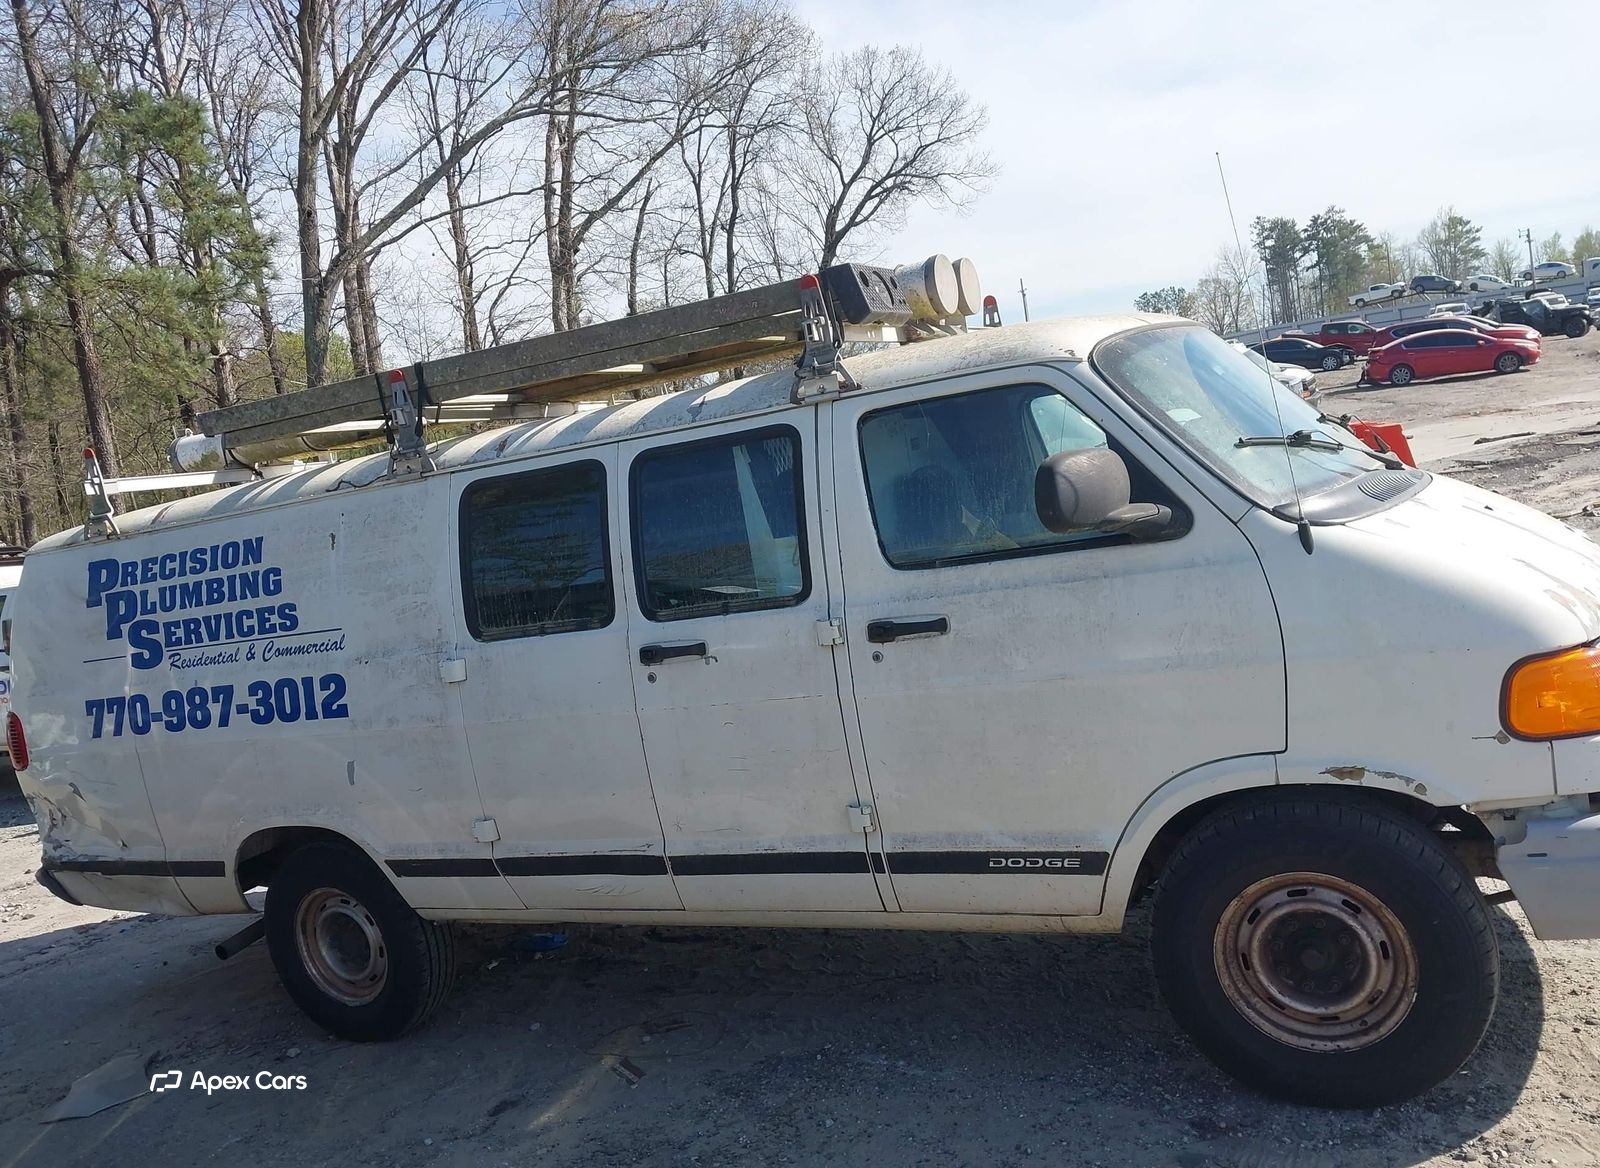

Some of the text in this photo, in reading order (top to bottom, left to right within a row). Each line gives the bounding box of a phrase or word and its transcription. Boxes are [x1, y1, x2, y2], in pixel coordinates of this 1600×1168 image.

[86, 536, 264, 608] PRECISION
[106, 567, 282, 640] PLUMBING
[128, 602, 299, 669] SERVICES
[168, 634, 346, 671] Residential & Commercial
[85, 673, 348, 739] 770-987-3012
[989, 858, 1081, 868] DODGE
